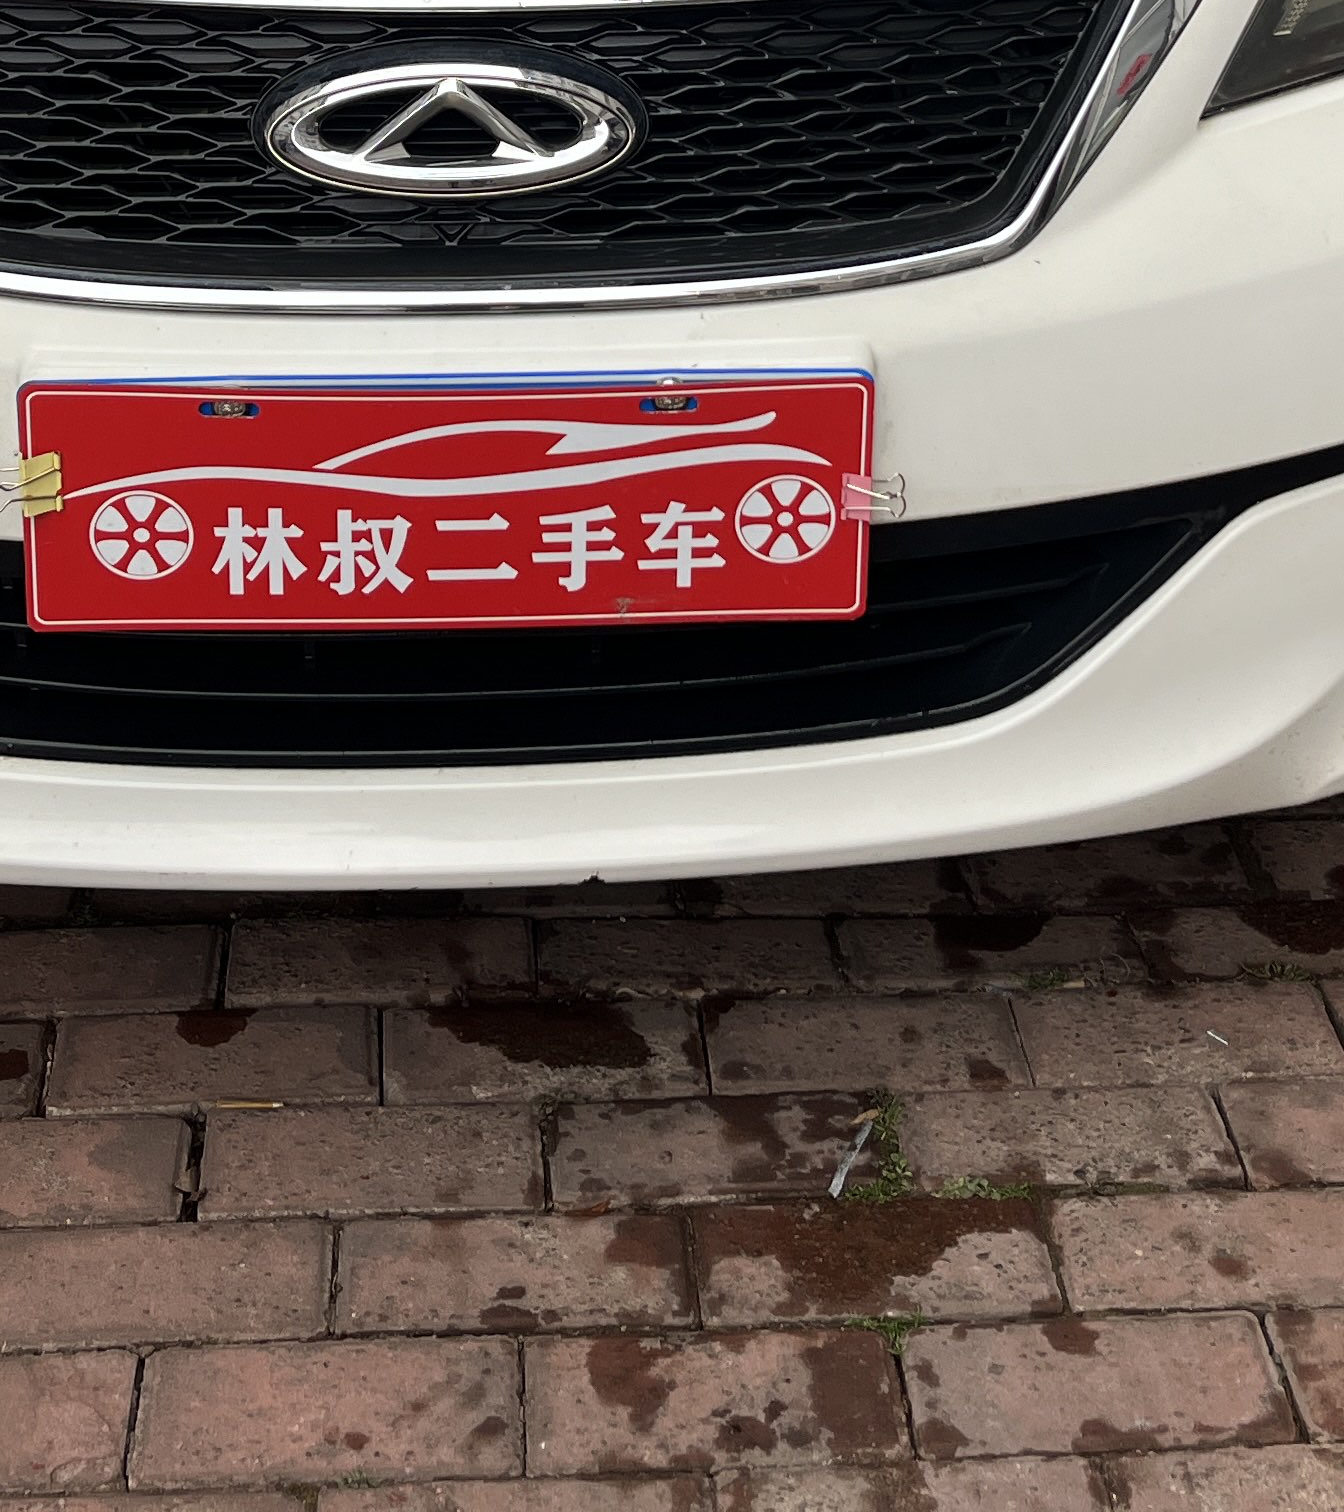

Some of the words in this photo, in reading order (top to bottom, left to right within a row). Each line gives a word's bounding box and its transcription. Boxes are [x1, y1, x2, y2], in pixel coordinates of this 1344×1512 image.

[211, 500, 726, 596] 林叔二手车
